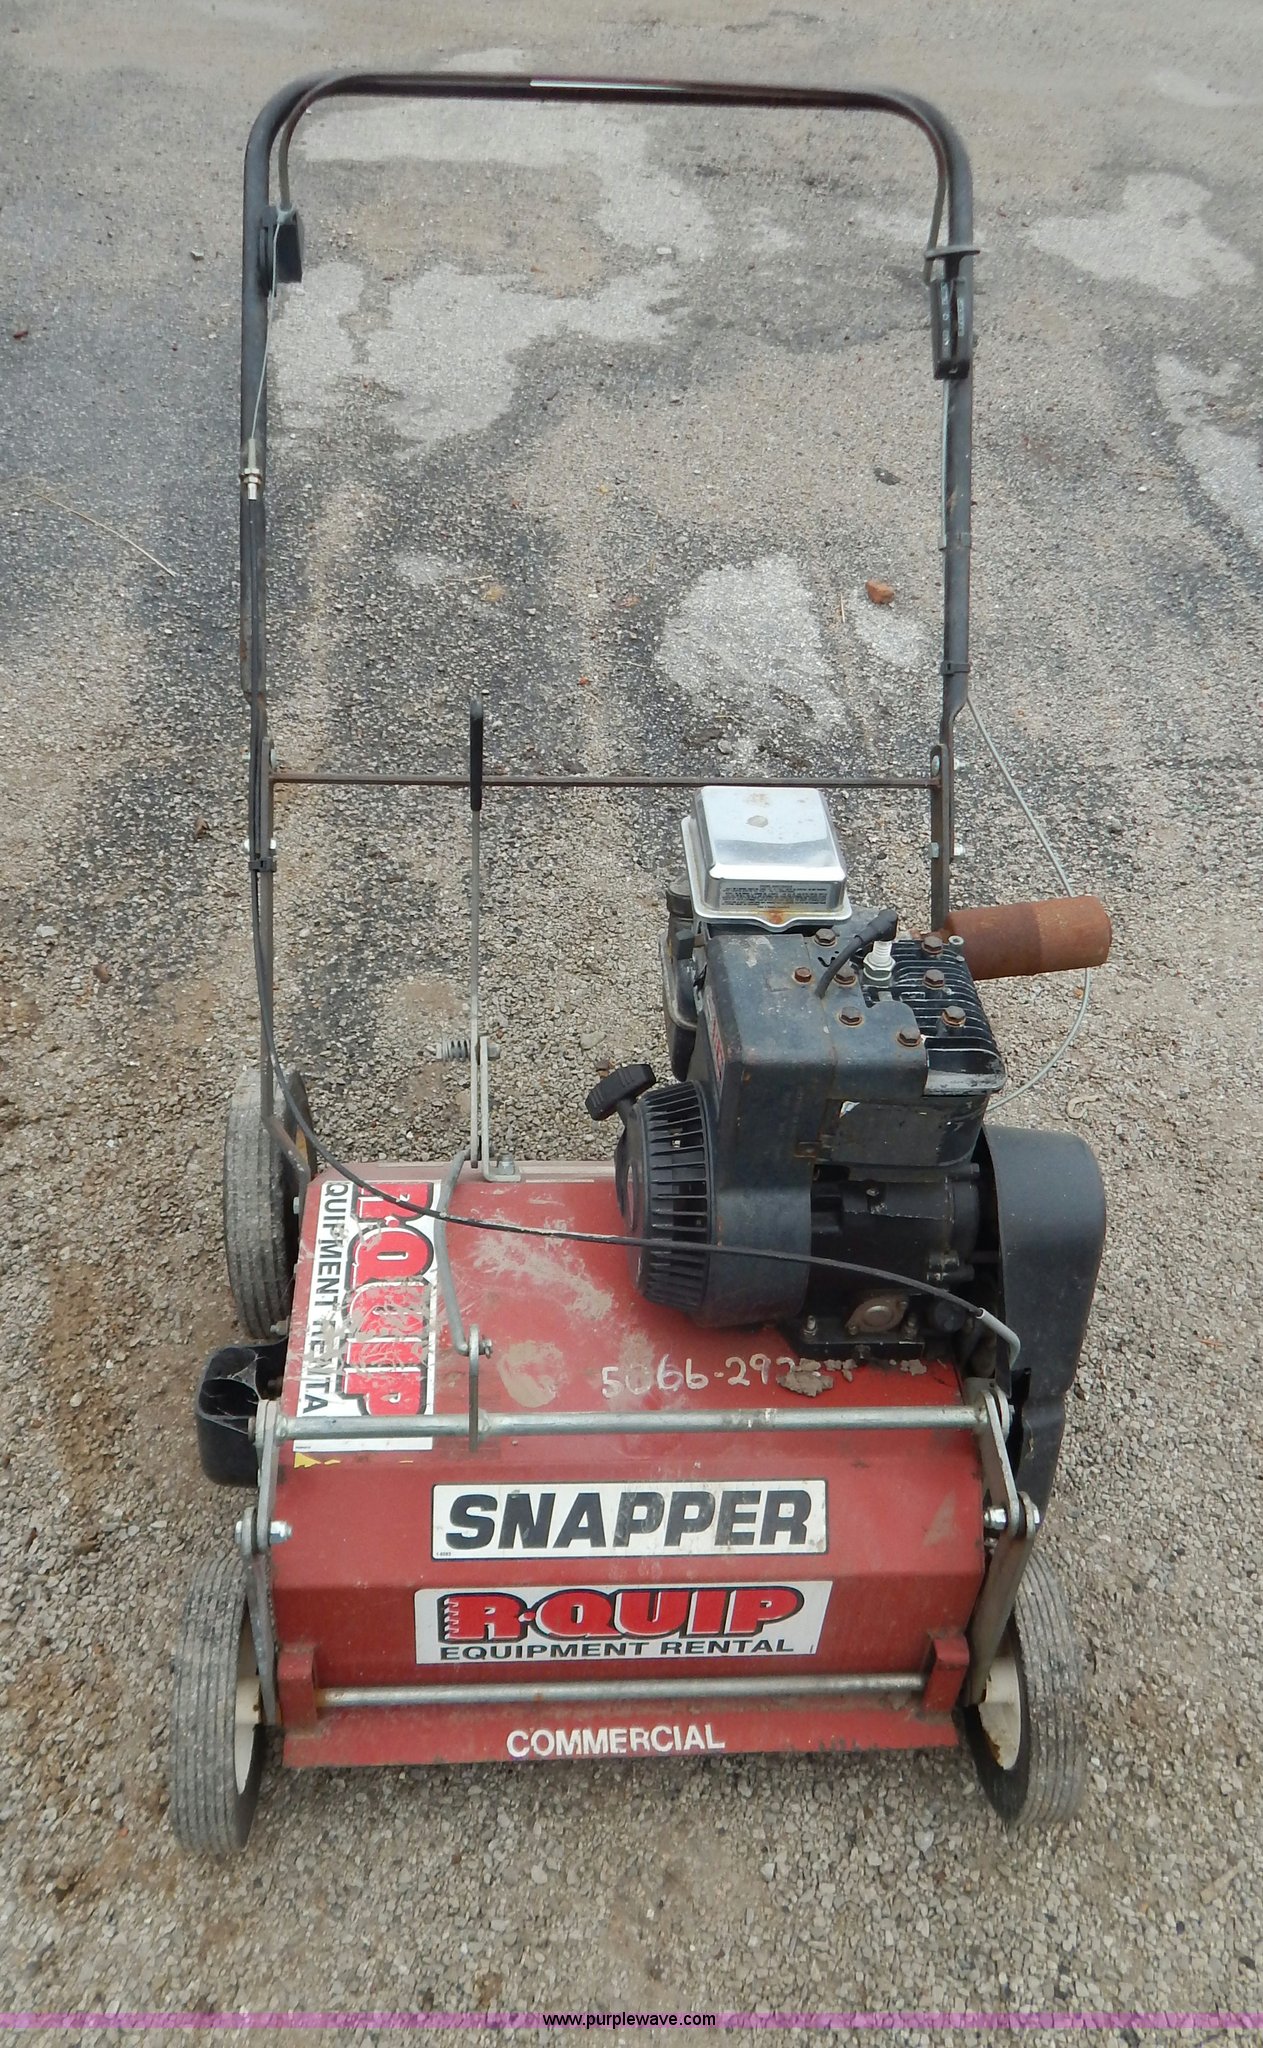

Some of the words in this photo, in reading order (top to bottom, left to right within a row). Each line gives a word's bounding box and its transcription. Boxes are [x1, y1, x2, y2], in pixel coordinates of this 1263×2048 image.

[445, 1489, 812, 1550] SNAPPER
[440, 1642, 650, 1661] EQUIPMENT
[660, 1638, 794, 1656] RENTAL
[506, 1724, 726, 1759] COMMERCIAL
